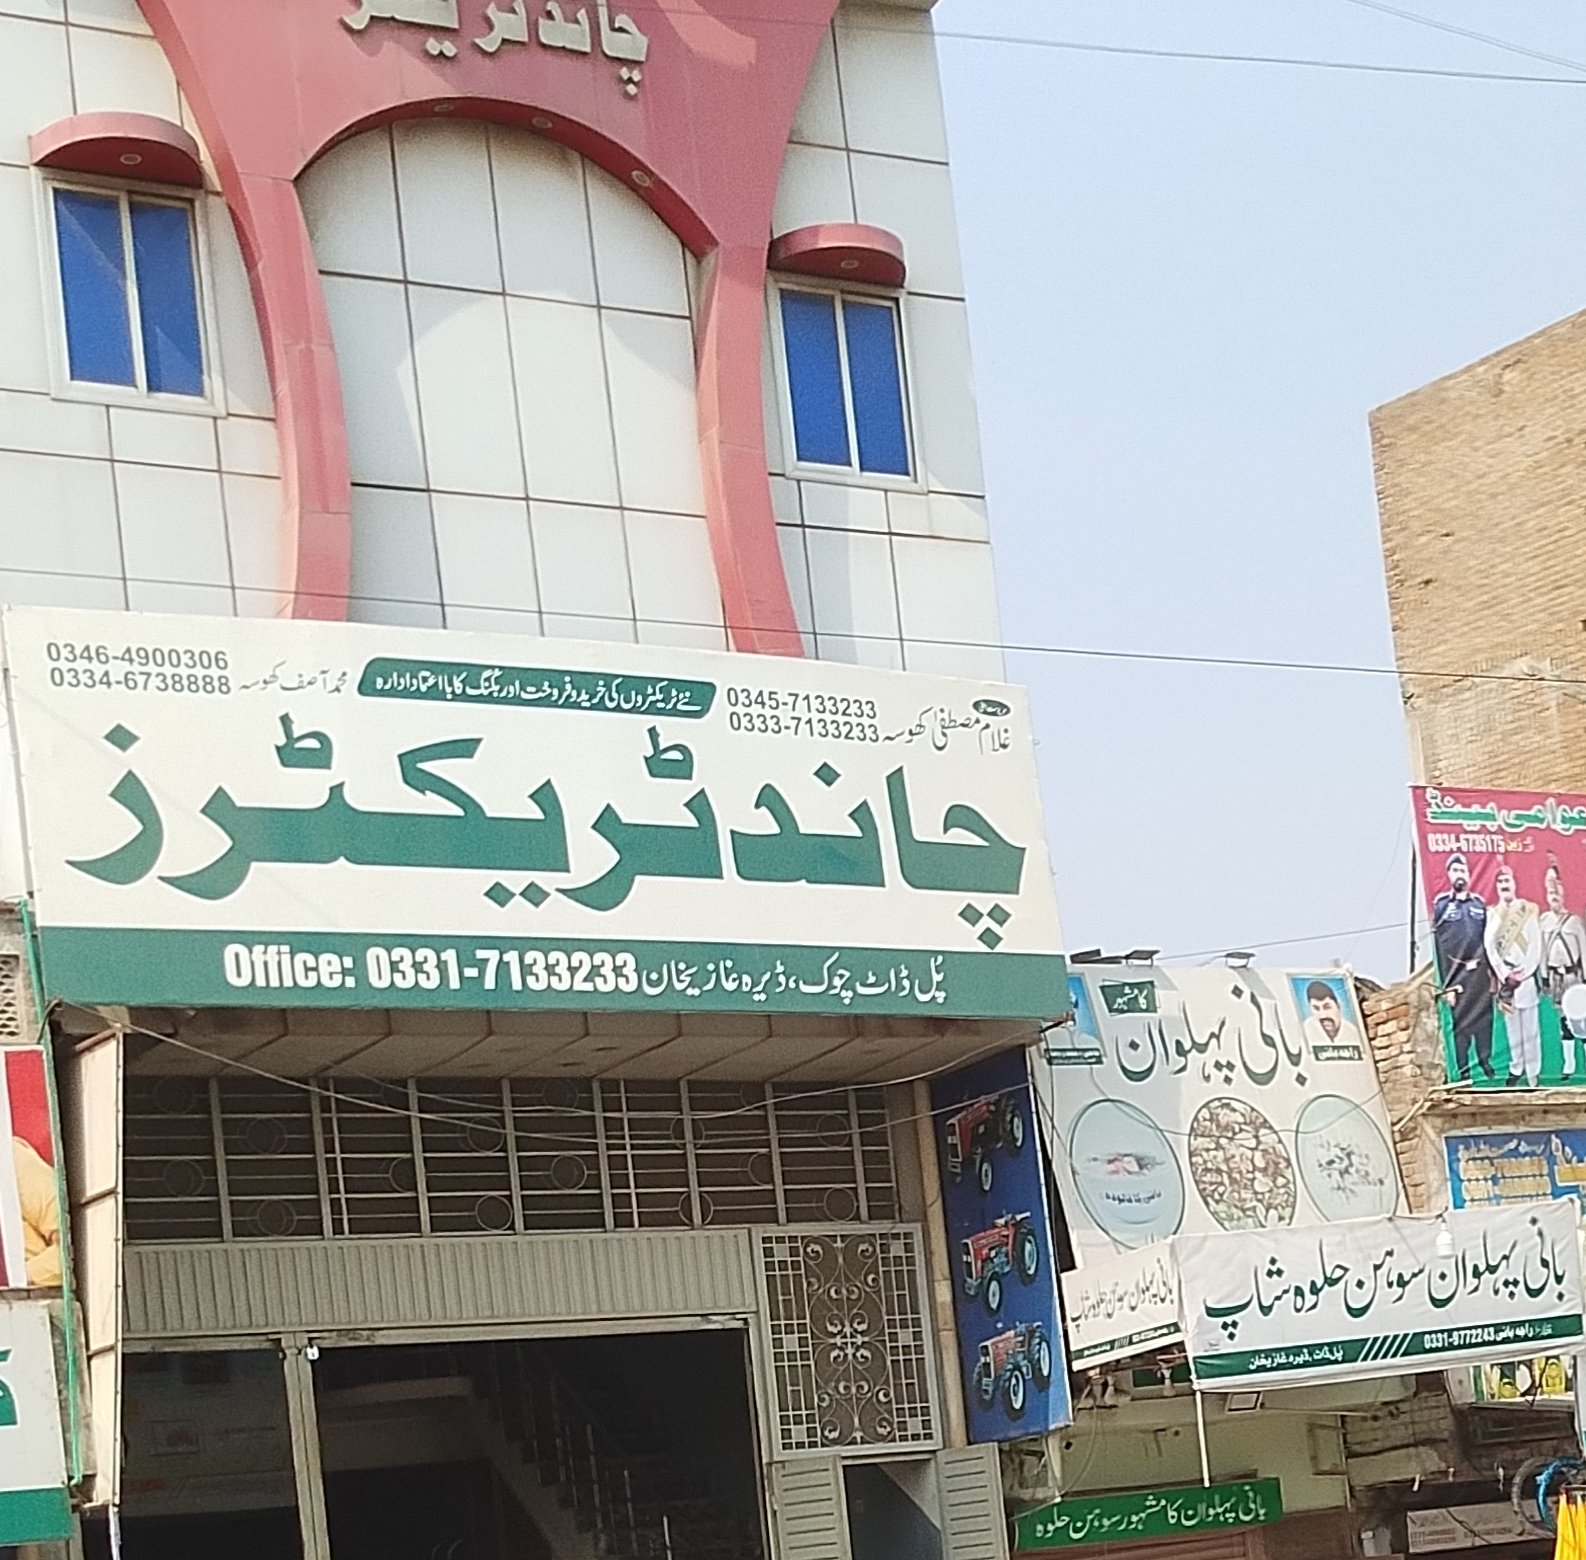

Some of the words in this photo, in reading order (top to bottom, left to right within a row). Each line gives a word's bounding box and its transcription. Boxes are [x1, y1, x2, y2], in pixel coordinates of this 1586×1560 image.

[46, 642, 228, 670] 0346-4900306
[50, 667, 231, 695] 0334-6738888
[280, 668, 329, 692] آصف
[453, 671, 467, 695] کا
[499, 680, 520, 698] اور
[604, 677, 623, 708] کی
[620, 681, 678, 711] ٹریکٹروں
[727, 687, 877, 719] 0345-7133233
[729, 711, 880, 743] 0333-7133233
[979, 722, 1010, 755] غلام
[729, 760, 1028, 949] چاند
[223, 943, 356, 988] Office:
[366, 946, 639, 993] 0331-7133233
[742, 960, 786, 1002] ڈیرہ
[855, 964, 911, 998] ڈاٹ
[1112, 985, 1139, 1011] مشہور
[1137, 988, 1148, 1010] کا
[1116, 1001, 1237, 1085] پہلوان
[1231, 983, 1308, 1087] بانی
[1293, 1238, 1350, 1313] حلوہ
[1428, 1228, 1518, 1309] پہلوان
[1524, 1216, 1567, 1303] بانی
[1204, 1255, 1292, 1342] شاپ
[1345, 1247, 1427, 1319] سوہن
[1117, 1494, 1167, 1531] مشہور
[1166, 1497, 1183, 1525] کا
[1181, 1494, 1236, 1526] پہلوان
[1239, 1484, 1267, 1521] بانی
[1035, 1506, 1070, 1538] حلوہ
